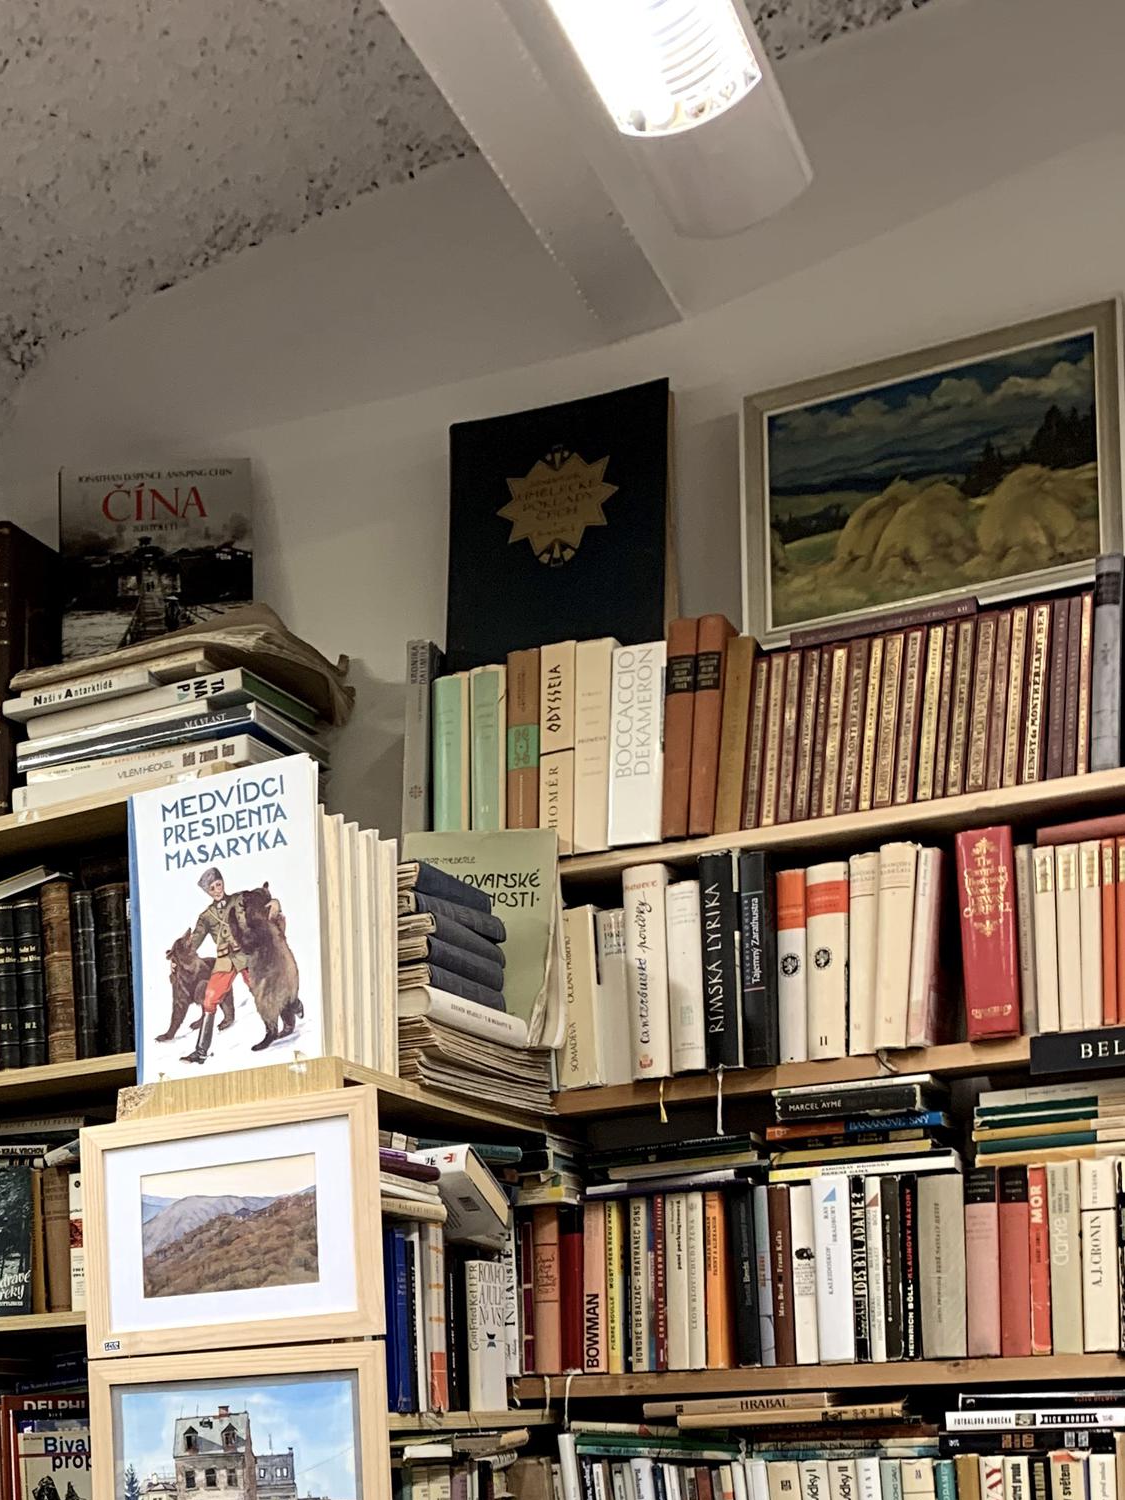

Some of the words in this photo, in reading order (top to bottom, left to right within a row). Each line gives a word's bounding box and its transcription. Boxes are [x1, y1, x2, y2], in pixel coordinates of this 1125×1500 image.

[102, 483, 208, 523] ČÍNA
[547, 664, 562, 733] ODYSSEIA
[615, 650, 636, 780] BOCCACCIO
[633, 647, 654, 778] DEKAMERON
[161, 774, 286, 823] MEDVÍDCI
[162, 803, 288, 847] PRESIDENTA
[164, 827, 289, 872] MASARYKA
[704, 883, 722, 951] LYRIKA
[788, 1101, 819, 1112] MARCEL
[821, 1099, 842, 1109] AYMÉ
[1031, 1184, 1043, 1224] MOR
[1090, 1215, 1102, 1265] CRONIN
[586, 1293, 599, 1369] BOWMAN
[907, 1311, 915, 1356] HEINRICH
[740, 1397, 789, 1408] HRABAL
[1058, 1464, 1072, 1495] světem
